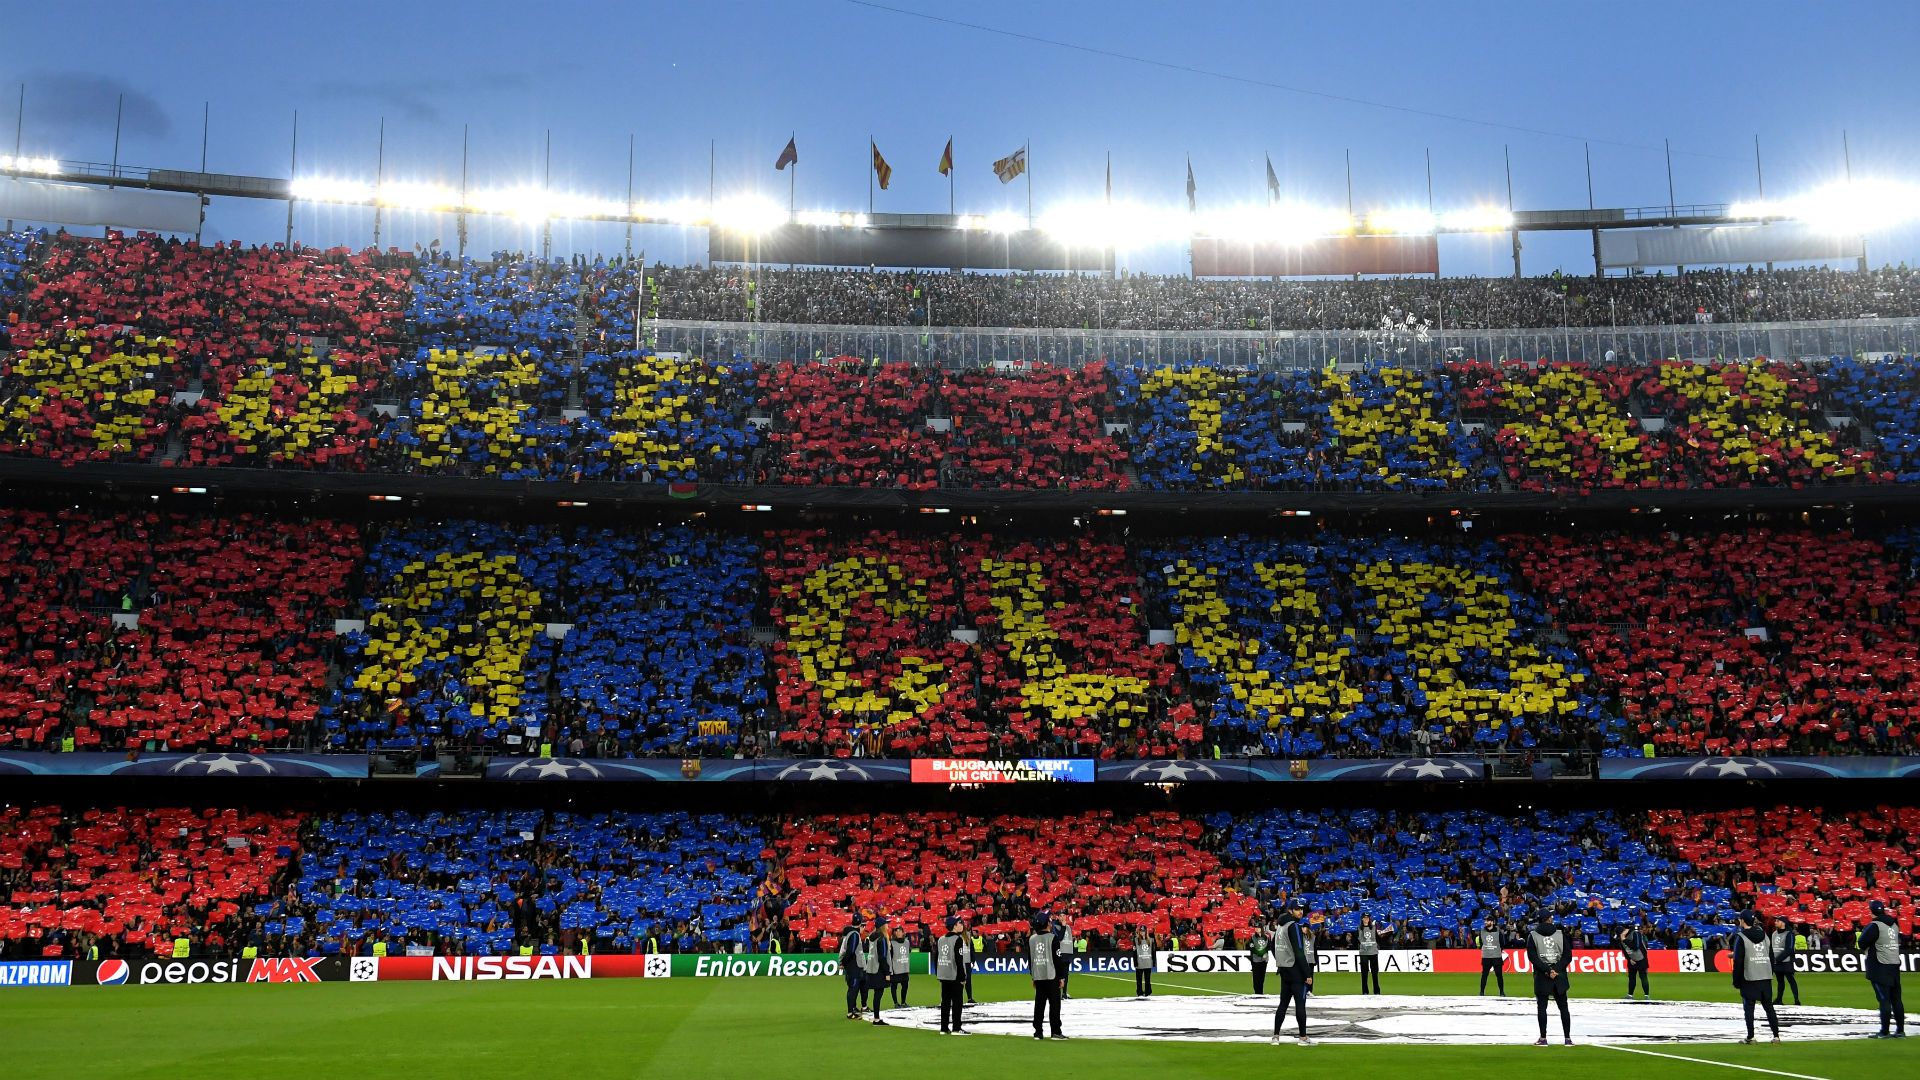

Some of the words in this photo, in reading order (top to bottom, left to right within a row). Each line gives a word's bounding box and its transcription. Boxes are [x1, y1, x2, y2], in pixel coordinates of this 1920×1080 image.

[783, 556, 1584, 732] CLUB
[932, 760, 1013, 771] BLAUGRANA
[1015, 760, 1033, 771] AL
[1034, 760, 1073, 772] VENT,
[949, 771, 966, 781] UN
[970, 771, 1001, 781] CRIT
[1002, 770, 1057, 782] VALENT,
[0, 964, 68, 985] AZPROM
[140, 958, 239, 985] pepsi
[246, 956, 328, 983] MAX
[431, 955, 592, 981] NISSAN
[767, 955, 844, 977] Respo
[1088, 956, 1137, 972] LEAGU
